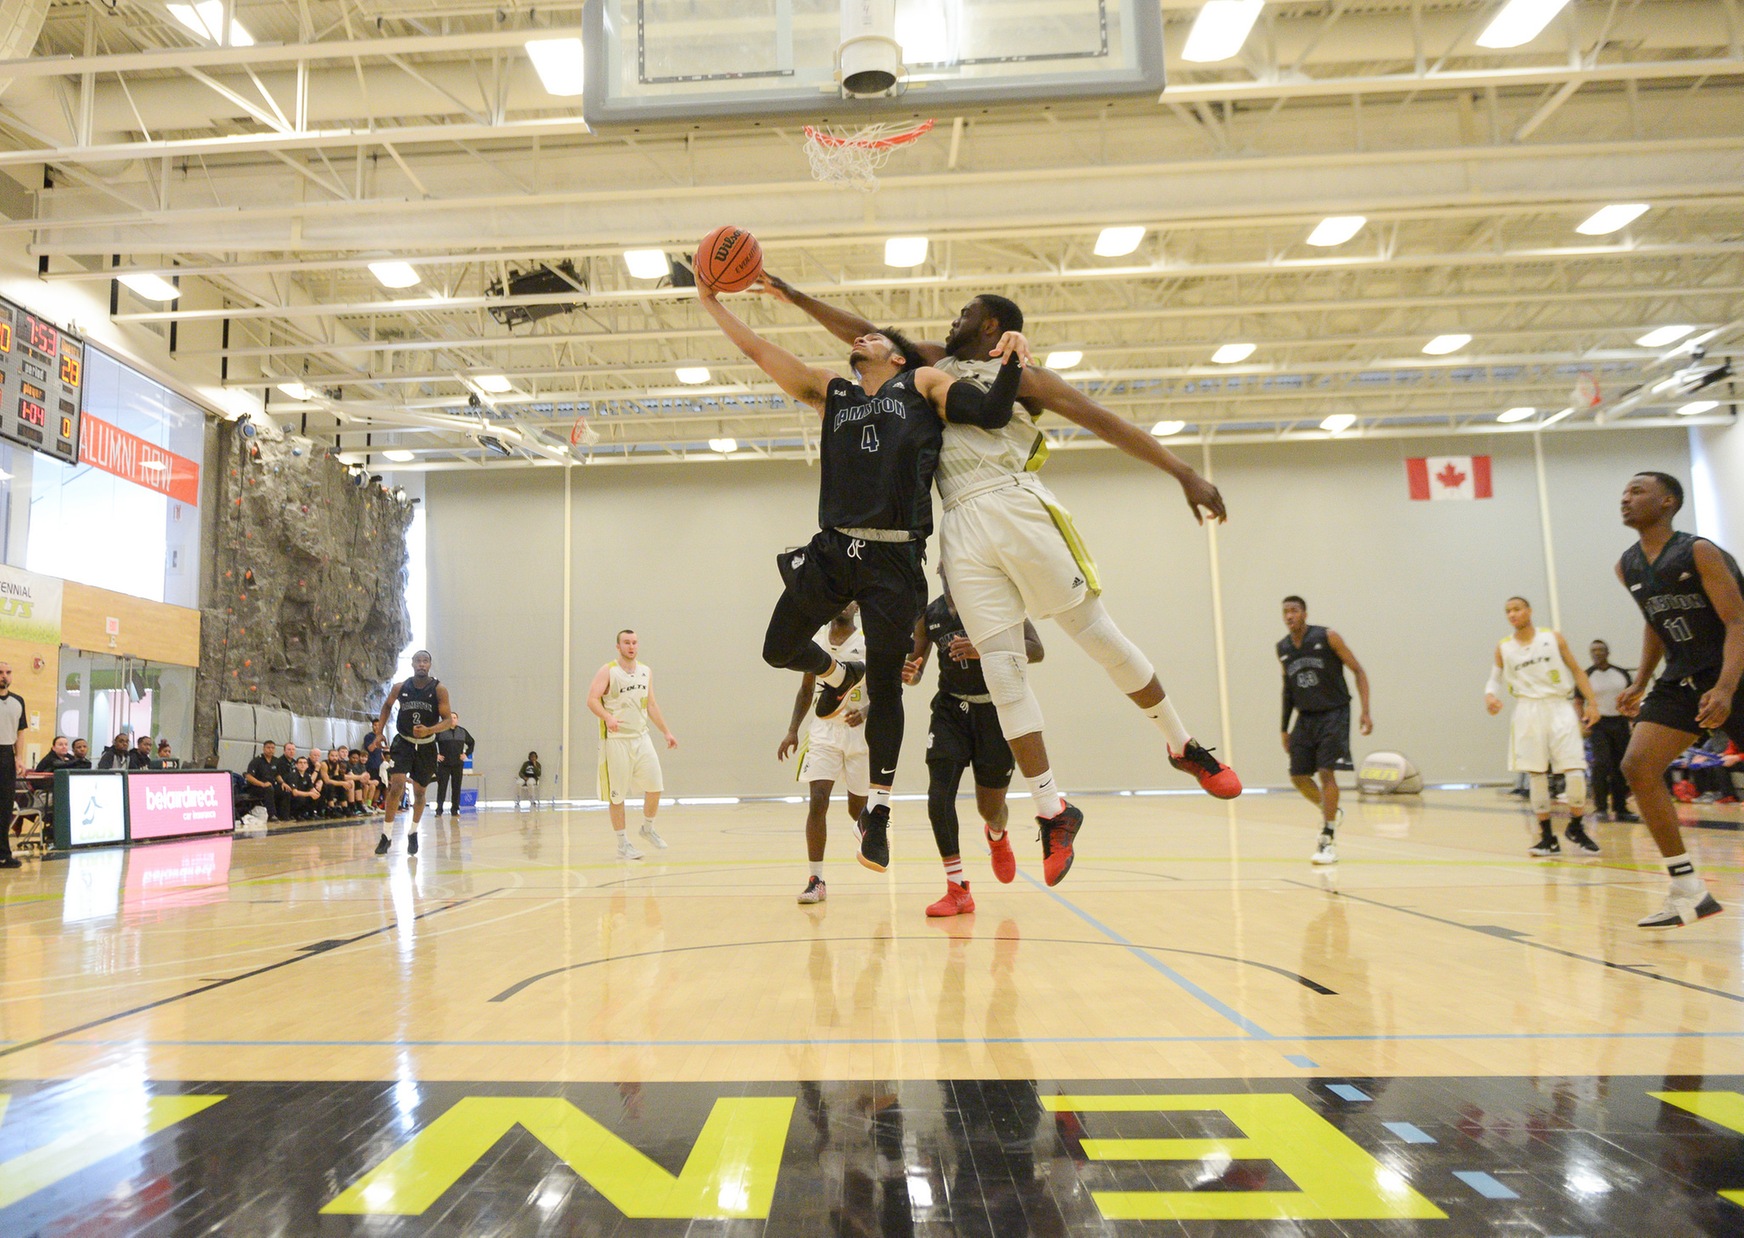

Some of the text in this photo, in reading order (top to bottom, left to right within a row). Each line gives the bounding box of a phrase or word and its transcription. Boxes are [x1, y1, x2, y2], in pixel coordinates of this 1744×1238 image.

[0, 322, 12, 354] 0
[26, 316, 57, 357] 7:53
[61, 355, 81, 388] 28
[63, 417, 71, 439] 0
[861, 424, 880, 453] 4
[79, 416, 173, 492] ALUMNI ROW
[1663, 617, 1693, 642] 11
[620, 684, 647, 693] COLTS
[412, 712, 421, 725] 2
